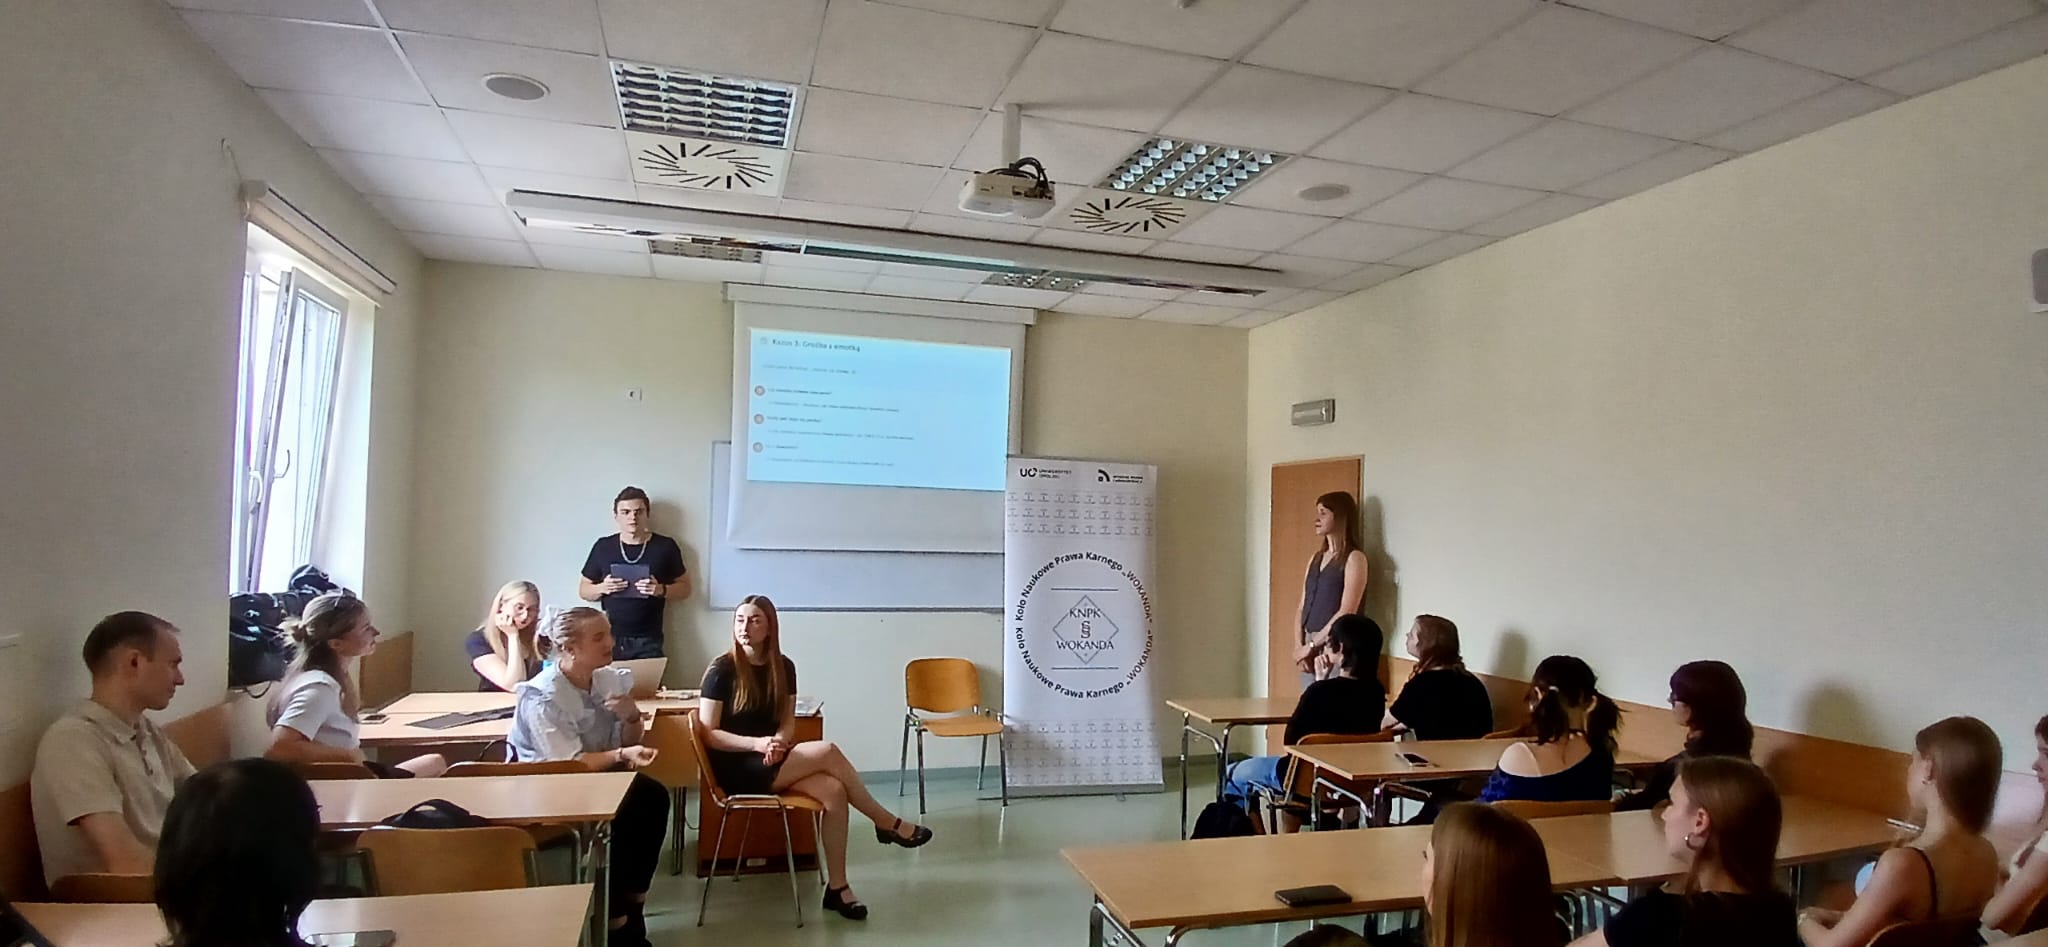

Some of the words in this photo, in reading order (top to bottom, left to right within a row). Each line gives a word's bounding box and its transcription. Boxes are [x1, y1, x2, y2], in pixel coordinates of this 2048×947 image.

[1021, 562, 1055, 599] Naukowe
[1054, 552, 1084, 566] Prawa
[1085, 551, 1123, 571] Karnego
[1069, 608, 1101, 618] KNPK
[1056, 640, 1115, 650] WOKANDA
[1021, 650, 1054, 689] Naukowe
[1054, 683, 1084, 699] Prawa
[1086, 681, 1124, 699] Karnego
